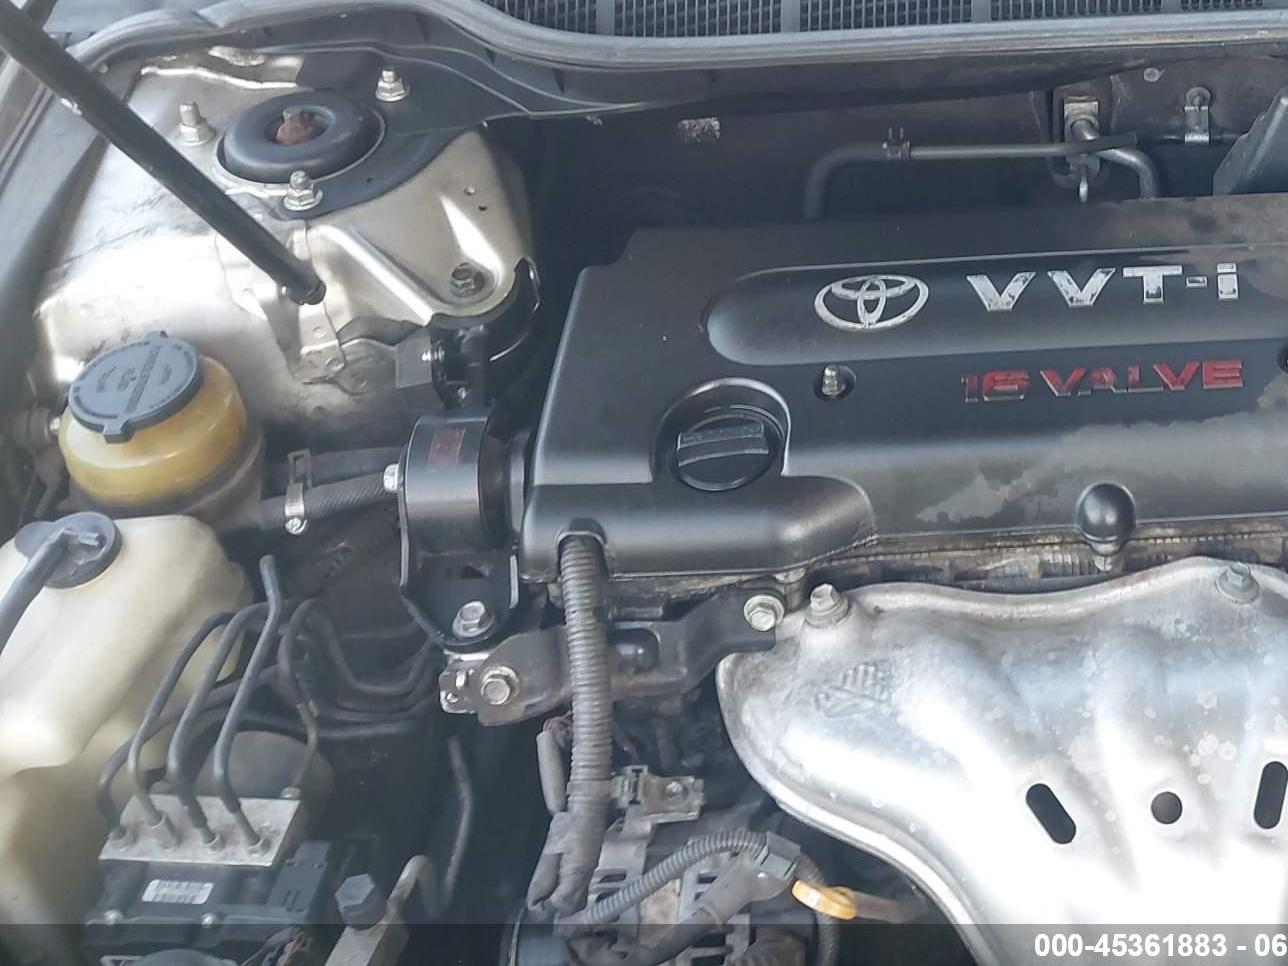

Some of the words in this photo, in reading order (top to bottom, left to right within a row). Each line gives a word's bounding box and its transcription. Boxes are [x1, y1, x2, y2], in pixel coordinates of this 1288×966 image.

[966, 262, 1239, 312] VVT-i
[960, 369, 1030, 403] 16
[1040, 360, 1243, 397] VALVE
